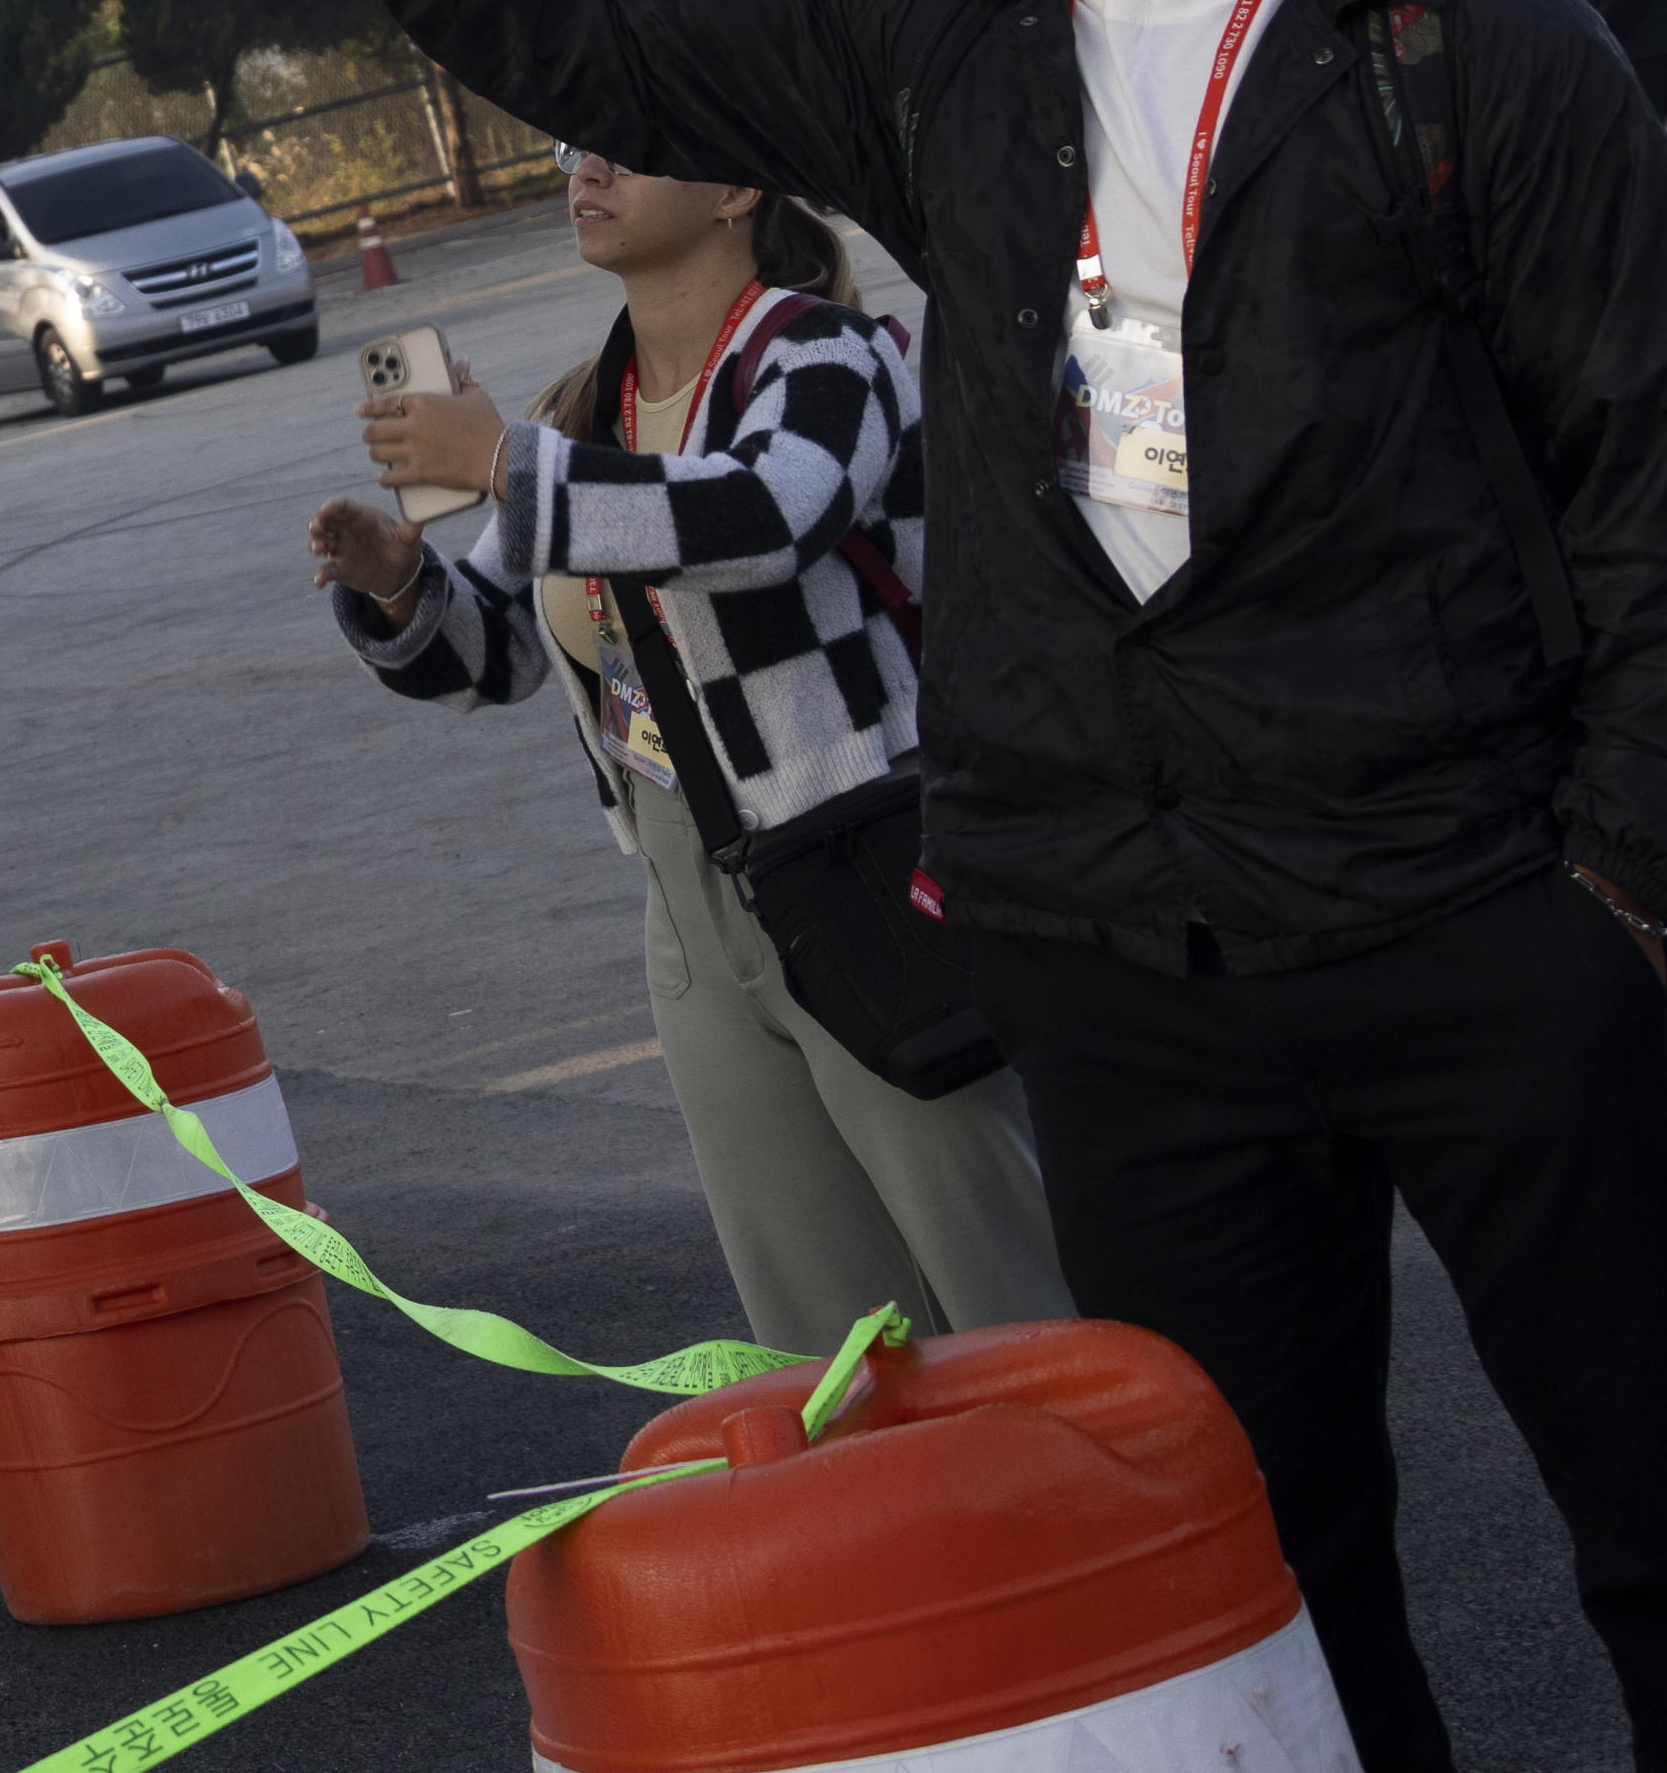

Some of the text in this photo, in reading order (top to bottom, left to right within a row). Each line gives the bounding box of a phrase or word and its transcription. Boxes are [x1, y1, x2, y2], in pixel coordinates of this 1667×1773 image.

[1189, 153, 1204, 187] Seoul
[1185, 189, 1198, 217] Tour
[1075, 383, 1140, 419] DMZ
[1144, 446, 1188, 474] 이연
[611, 679, 642, 708] DMZ
[360, 1539, 503, 1626] SAFETY
[258, 1621, 353, 1679] LINE
